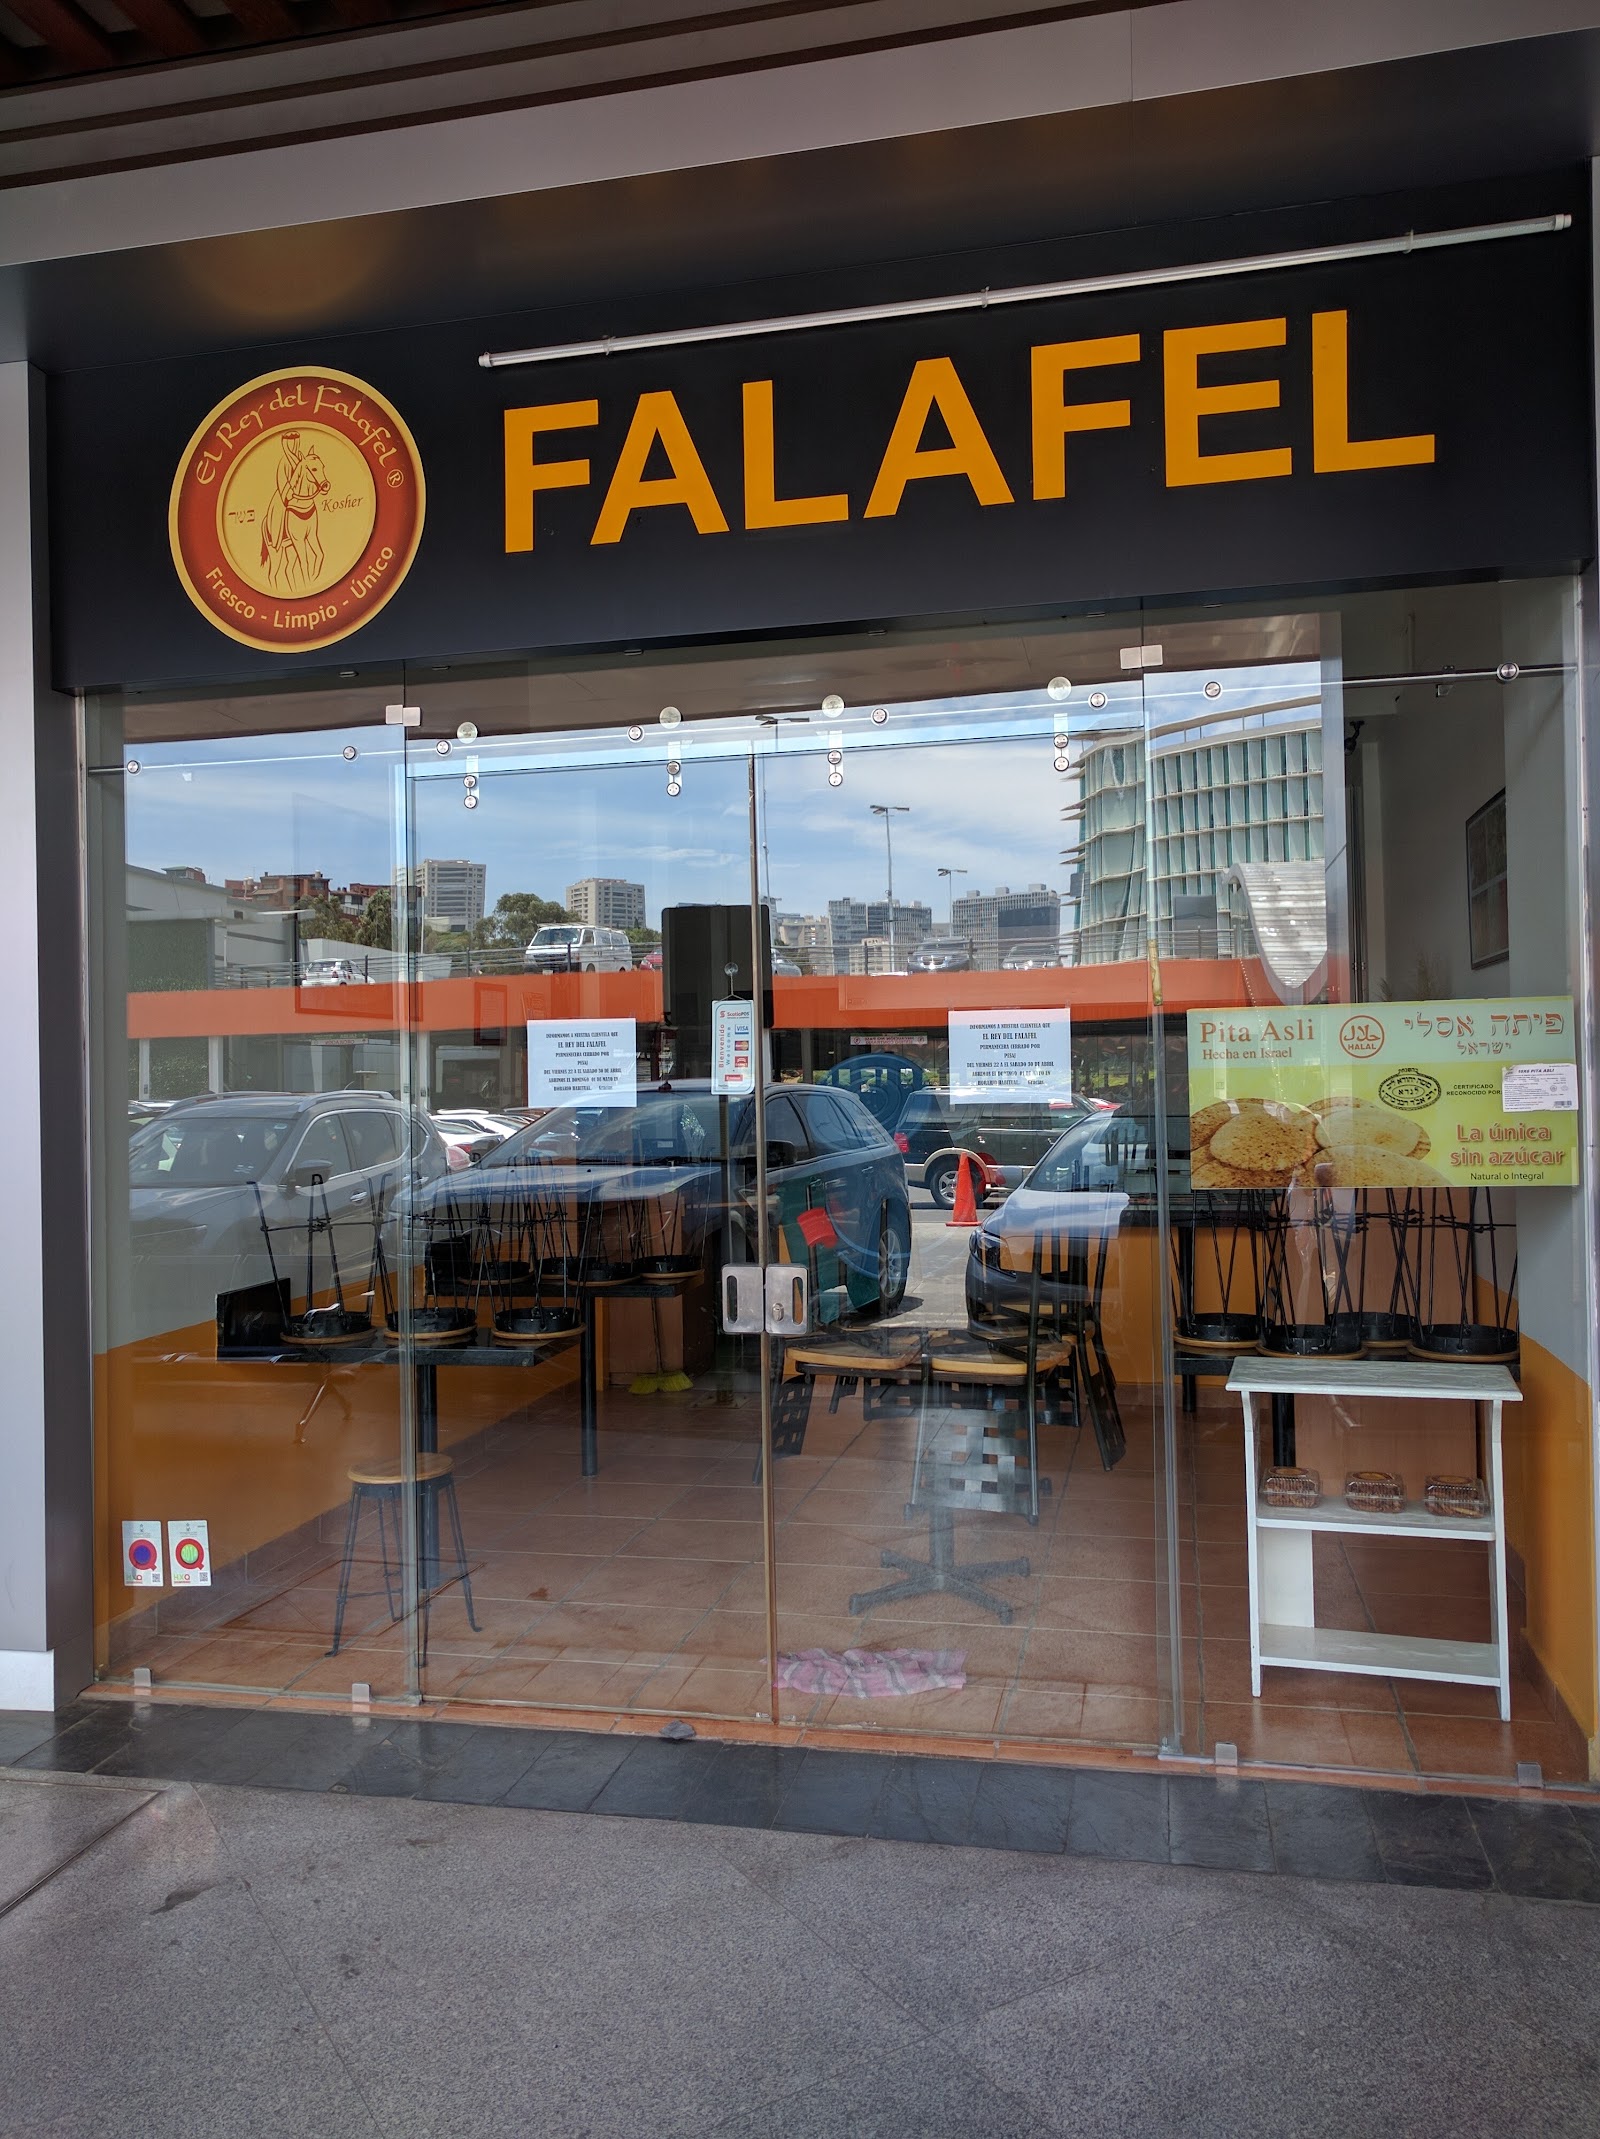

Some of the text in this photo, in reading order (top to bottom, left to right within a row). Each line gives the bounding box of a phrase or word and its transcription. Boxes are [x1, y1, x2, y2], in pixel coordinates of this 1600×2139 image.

[196, 450, 222, 485] El
[216, 407, 264, 450] Rey
[269, 384, 310, 412] del
[309, 384, 399, 468] Falafel
[504, 310, 1434, 553] FALAFEL
[322, 494, 364, 512] Kosher
[205, 567, 255, 620] Fresco
[273, 604, 338, 630] Limpio
[350, 546, 394, 600] Único
[1200, 1018, 1314, 1043] Pita Asli
[1343, 1024, 1381, 1042] حلال
[1404, 1012, 1564, 1038] פיתה אסלי
[1202, 1047, 1292, 1060] Hecha en Israel
[1457, 1041, 1512, 1055] ישראל
[1457, 1123, 1552, 1142] La única
[1450, 1146, 1565, 1166] sin azúcar
[1470, 1172, 1502, 1180] Natural
[1511, 1172, 1544, 1182] Integral
